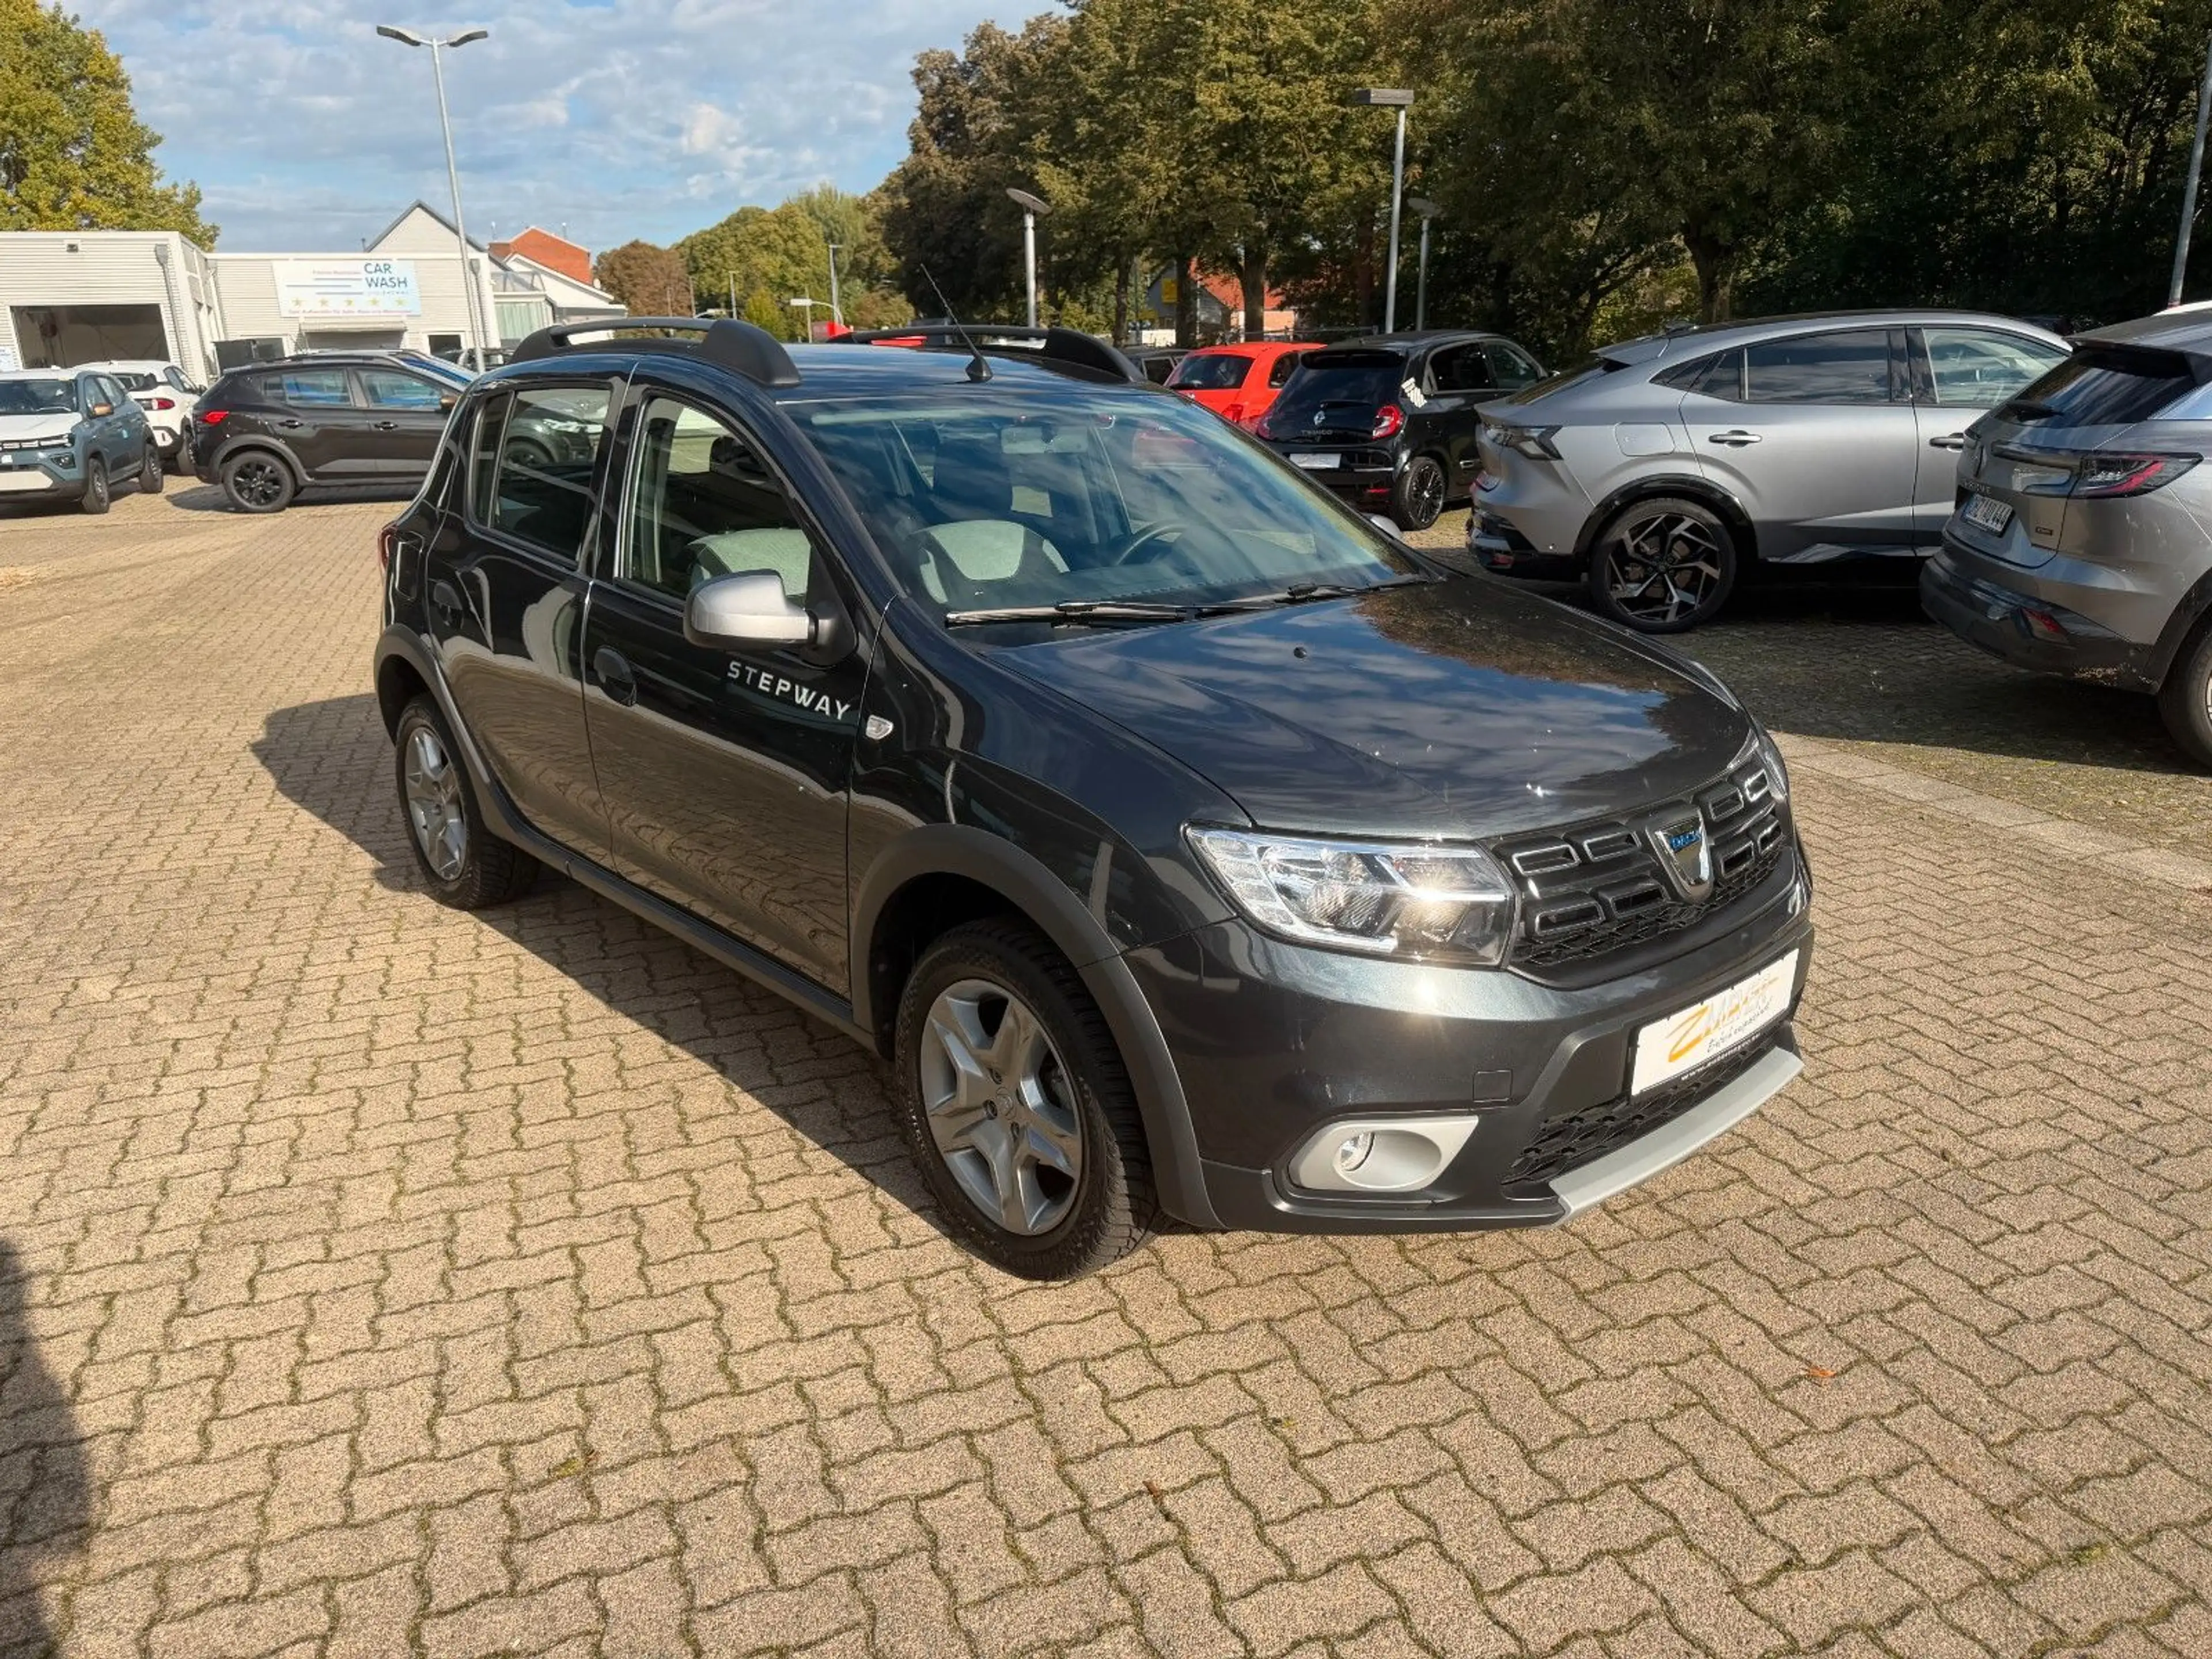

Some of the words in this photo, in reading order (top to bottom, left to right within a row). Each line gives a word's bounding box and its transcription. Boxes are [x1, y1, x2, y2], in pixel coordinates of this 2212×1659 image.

[364, 263, 392, 274] CAR
[365, 276, 408, 288] WASH
[727, 661, 851, 720] STEPWAY
